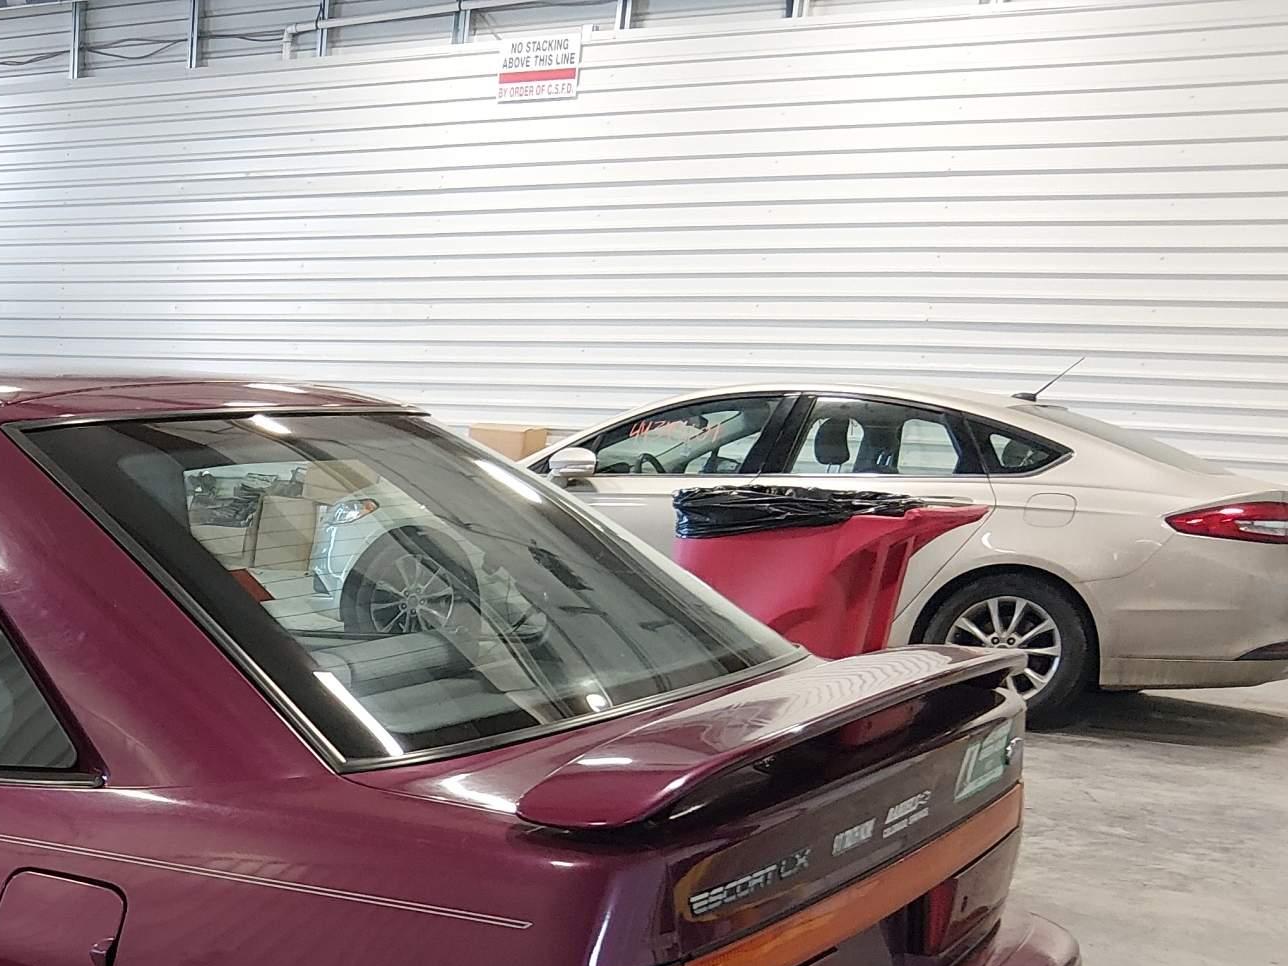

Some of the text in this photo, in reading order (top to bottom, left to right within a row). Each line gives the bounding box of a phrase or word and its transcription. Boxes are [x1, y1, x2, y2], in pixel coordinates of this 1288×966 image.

[510, 38, 569, 54] NO STACKING
[502, 52, 576, 69] ABOVE THIS LINE
[498, 87, 508, 98] BY
[509, 85, 534, 98] ORDER
[535, 84, 546, 96] OF
[688, 848, 812, 915] ESCORT LX
